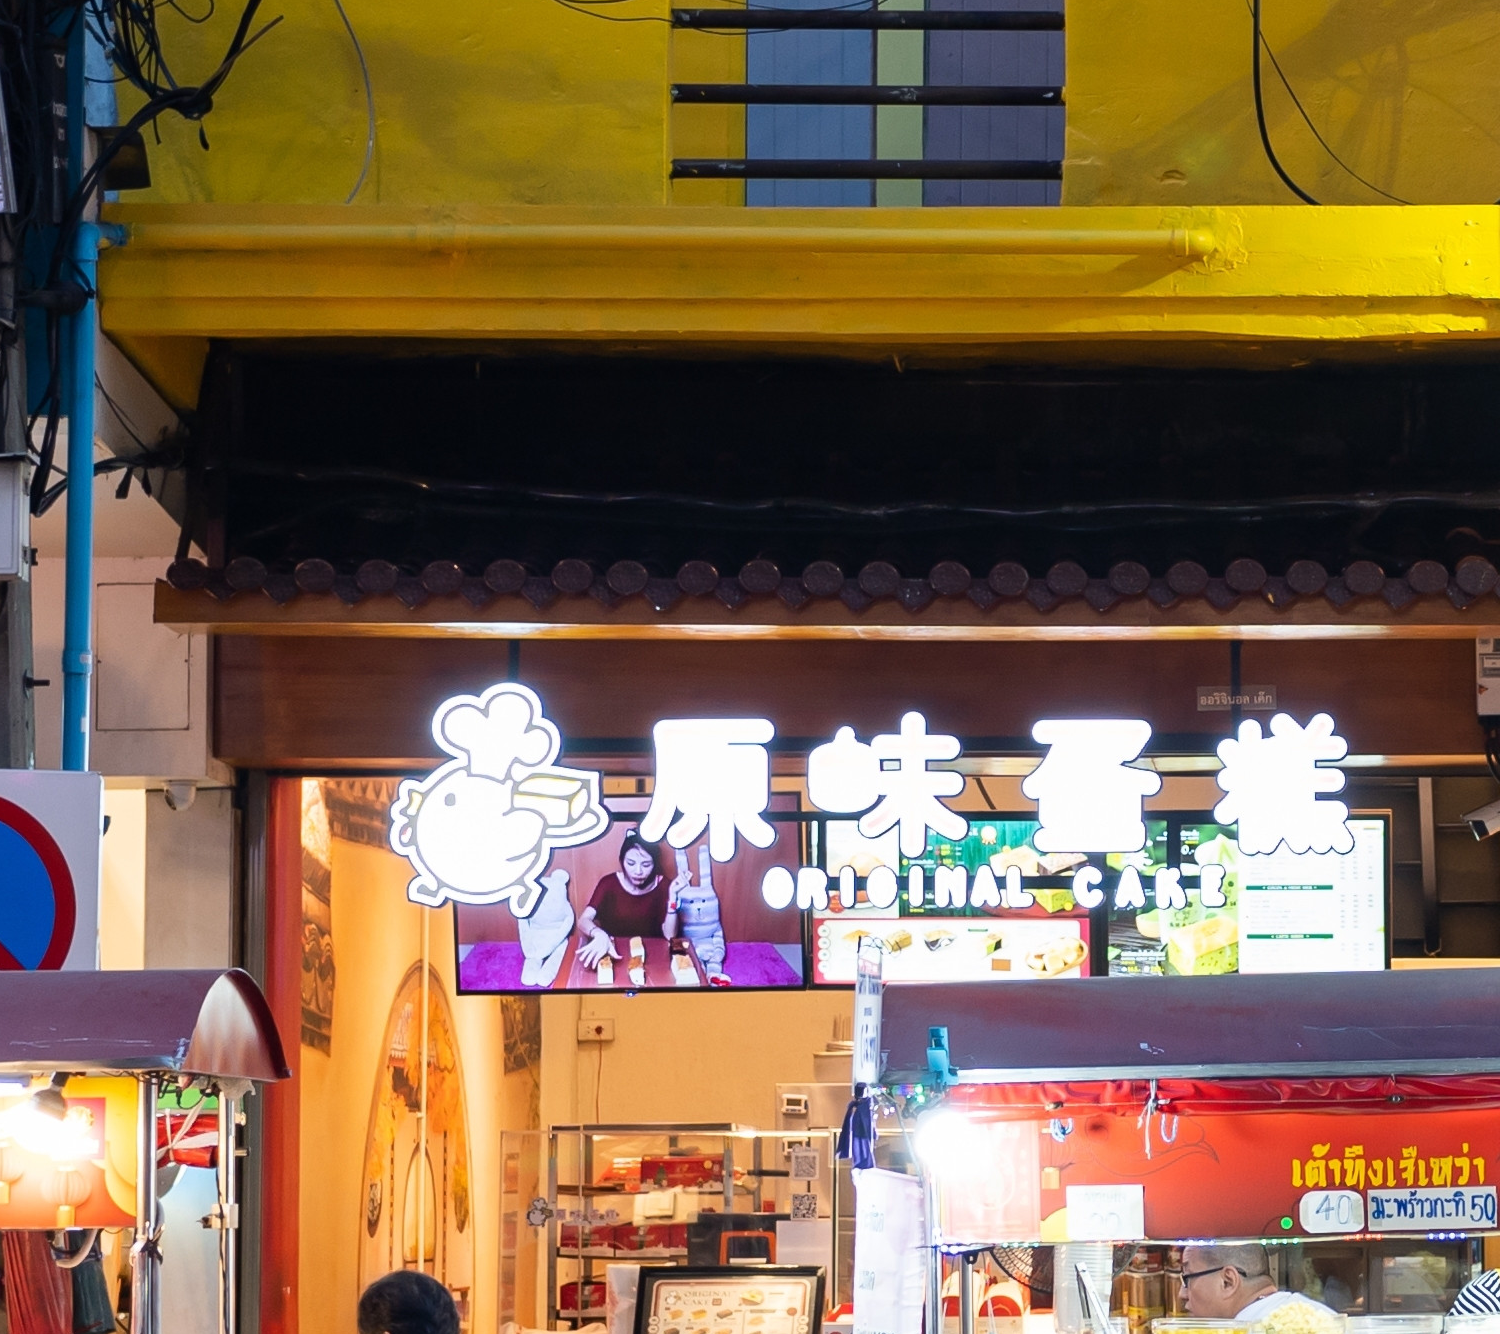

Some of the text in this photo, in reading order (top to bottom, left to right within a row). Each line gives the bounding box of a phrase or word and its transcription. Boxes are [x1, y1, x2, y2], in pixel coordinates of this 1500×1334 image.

[638, 711, 1358, 860] 原味蛋糕
[1071, 864, 1228, 910] CAKE
